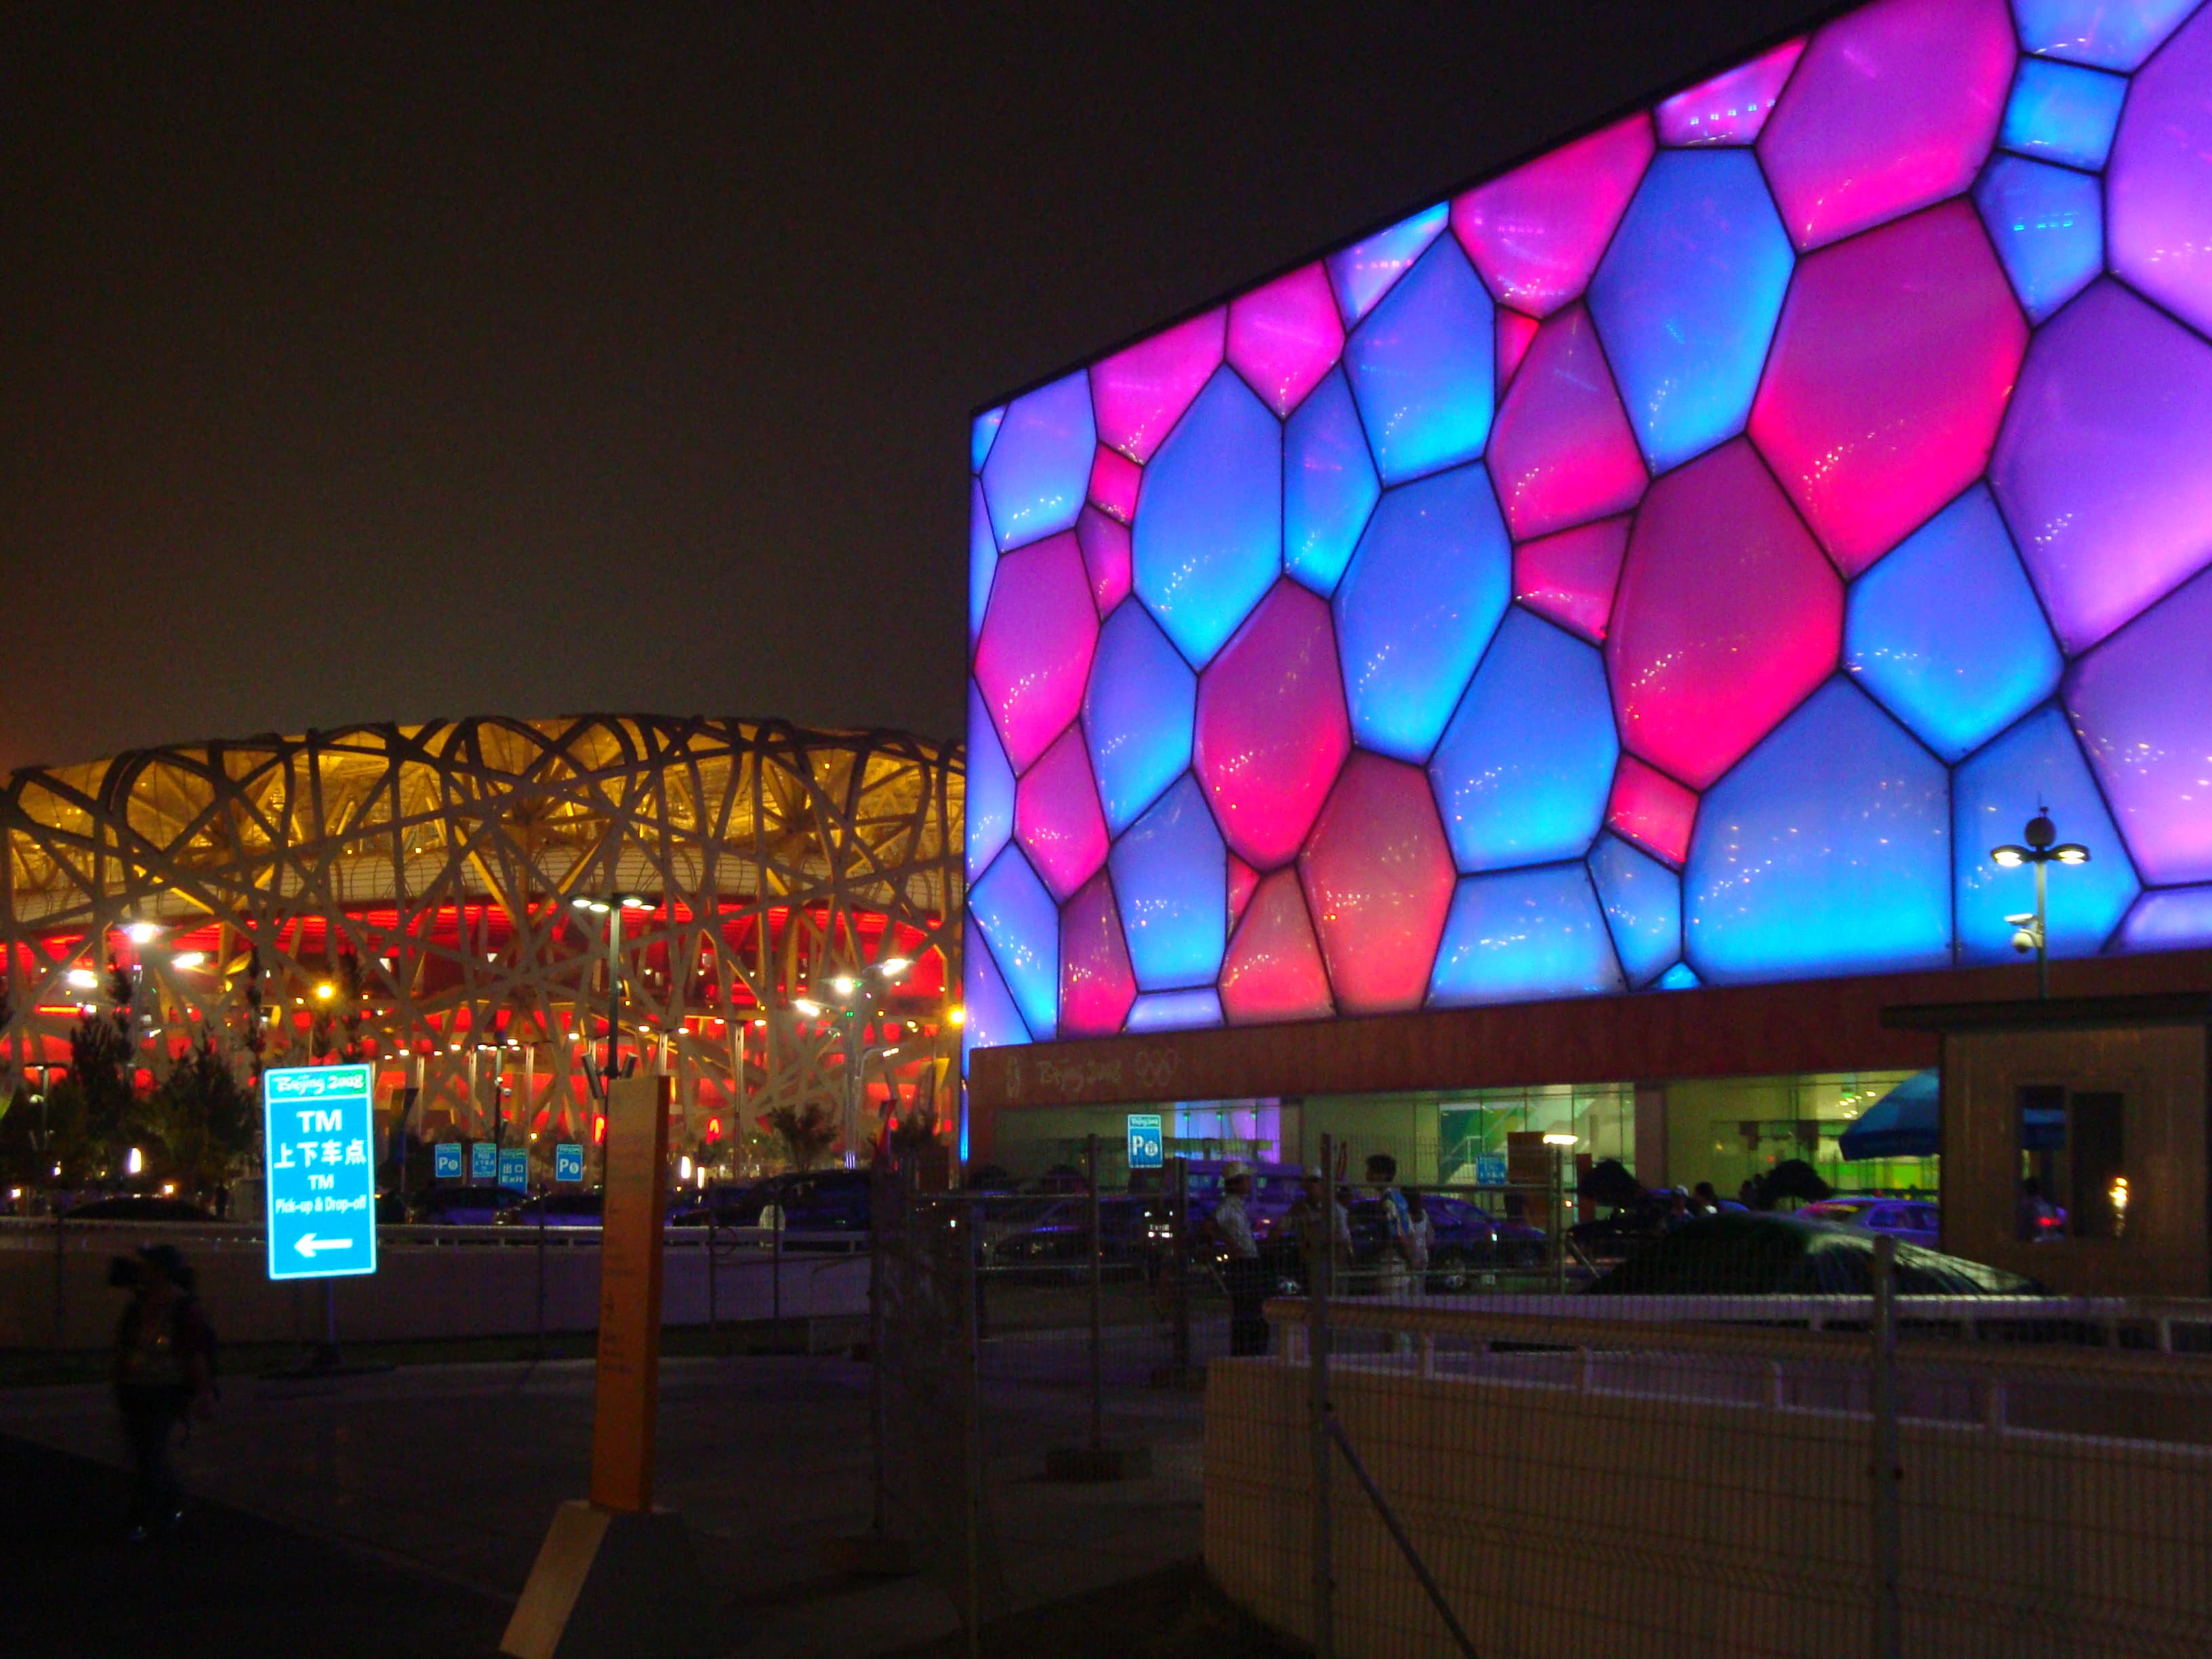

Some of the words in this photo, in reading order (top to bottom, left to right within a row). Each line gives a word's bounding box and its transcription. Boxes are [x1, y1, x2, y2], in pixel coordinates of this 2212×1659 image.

[272, 1075, 325, 1095] Beijing
[327, 1074, 363, 1089] 2008
[296, 1109, 342, 1133] TM
[274, 1138, 367, 1168] 上下车点
[307, 1174, 334, 1191] TM
[275, 1197, 313, 1215] Pick-up
[314, 1196, 323, 1212] &
[325, 1194, 367, 1214] Drop-off
